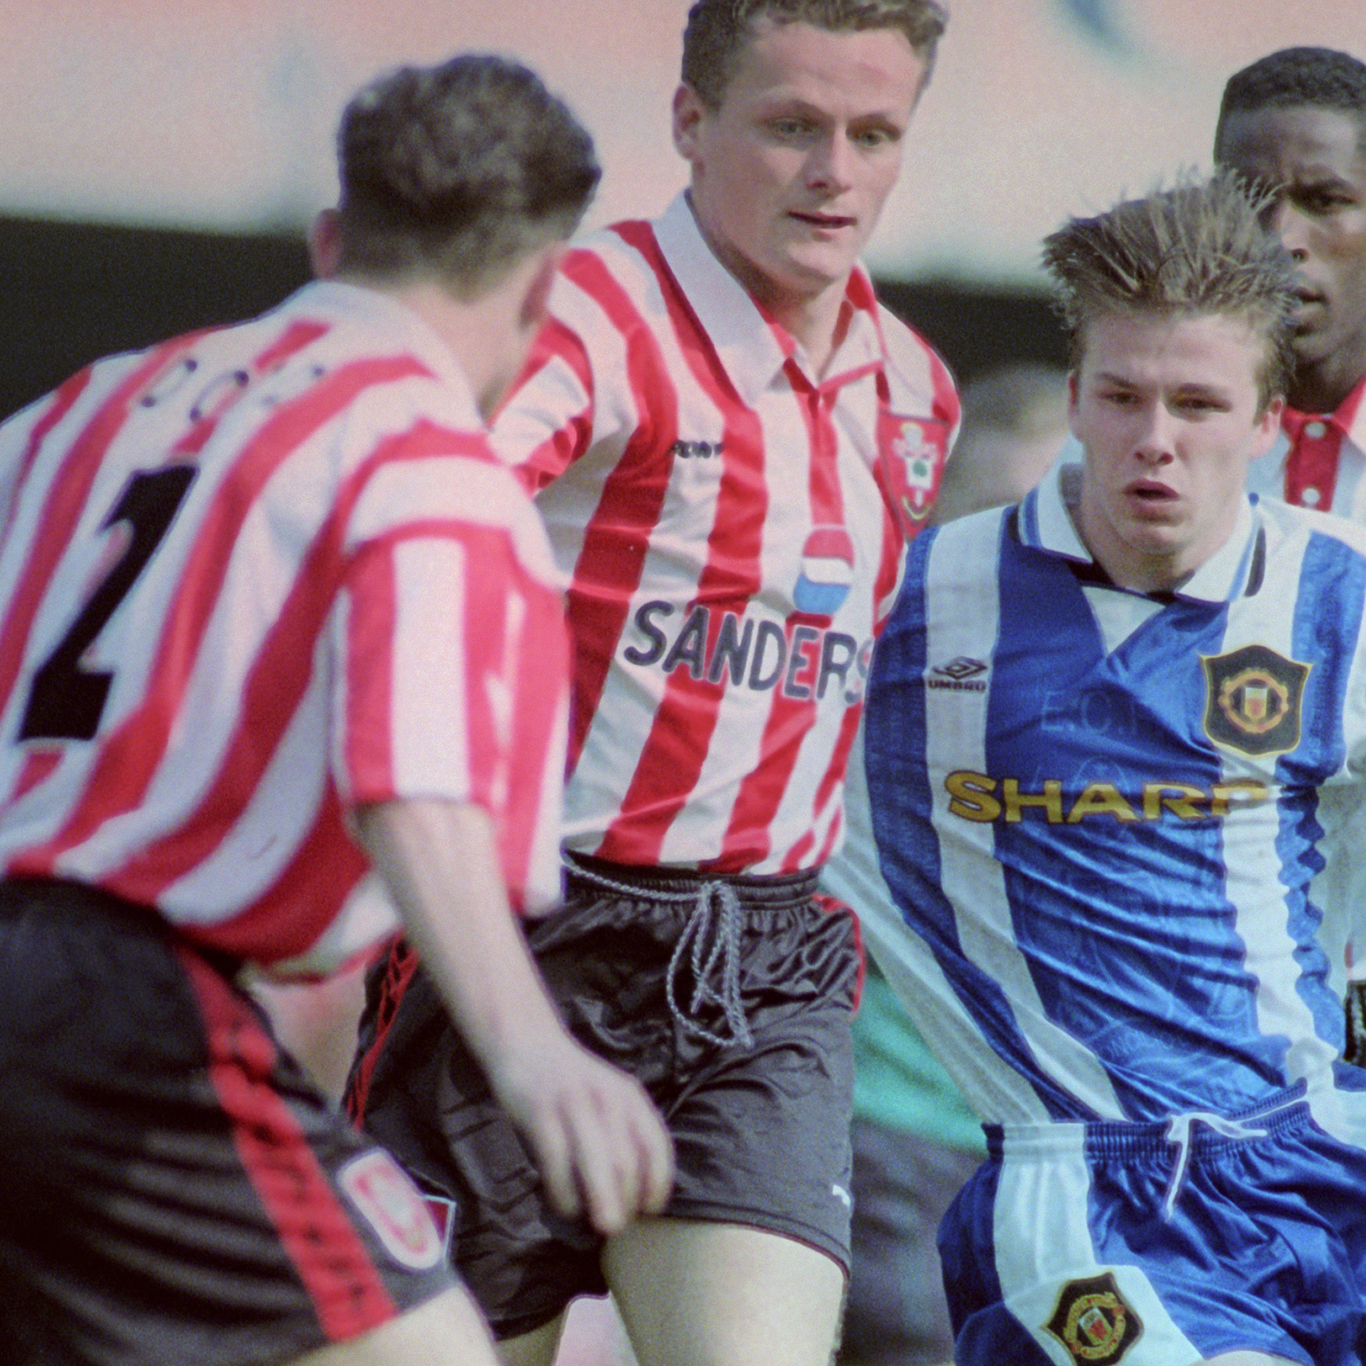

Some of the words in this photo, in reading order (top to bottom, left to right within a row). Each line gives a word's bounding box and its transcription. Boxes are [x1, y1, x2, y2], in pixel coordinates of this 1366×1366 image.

[13, 462, 200, 745] 2
[927, 680, 987, 692] UMBRO
[944, 769, 1274, 824] SHARP
